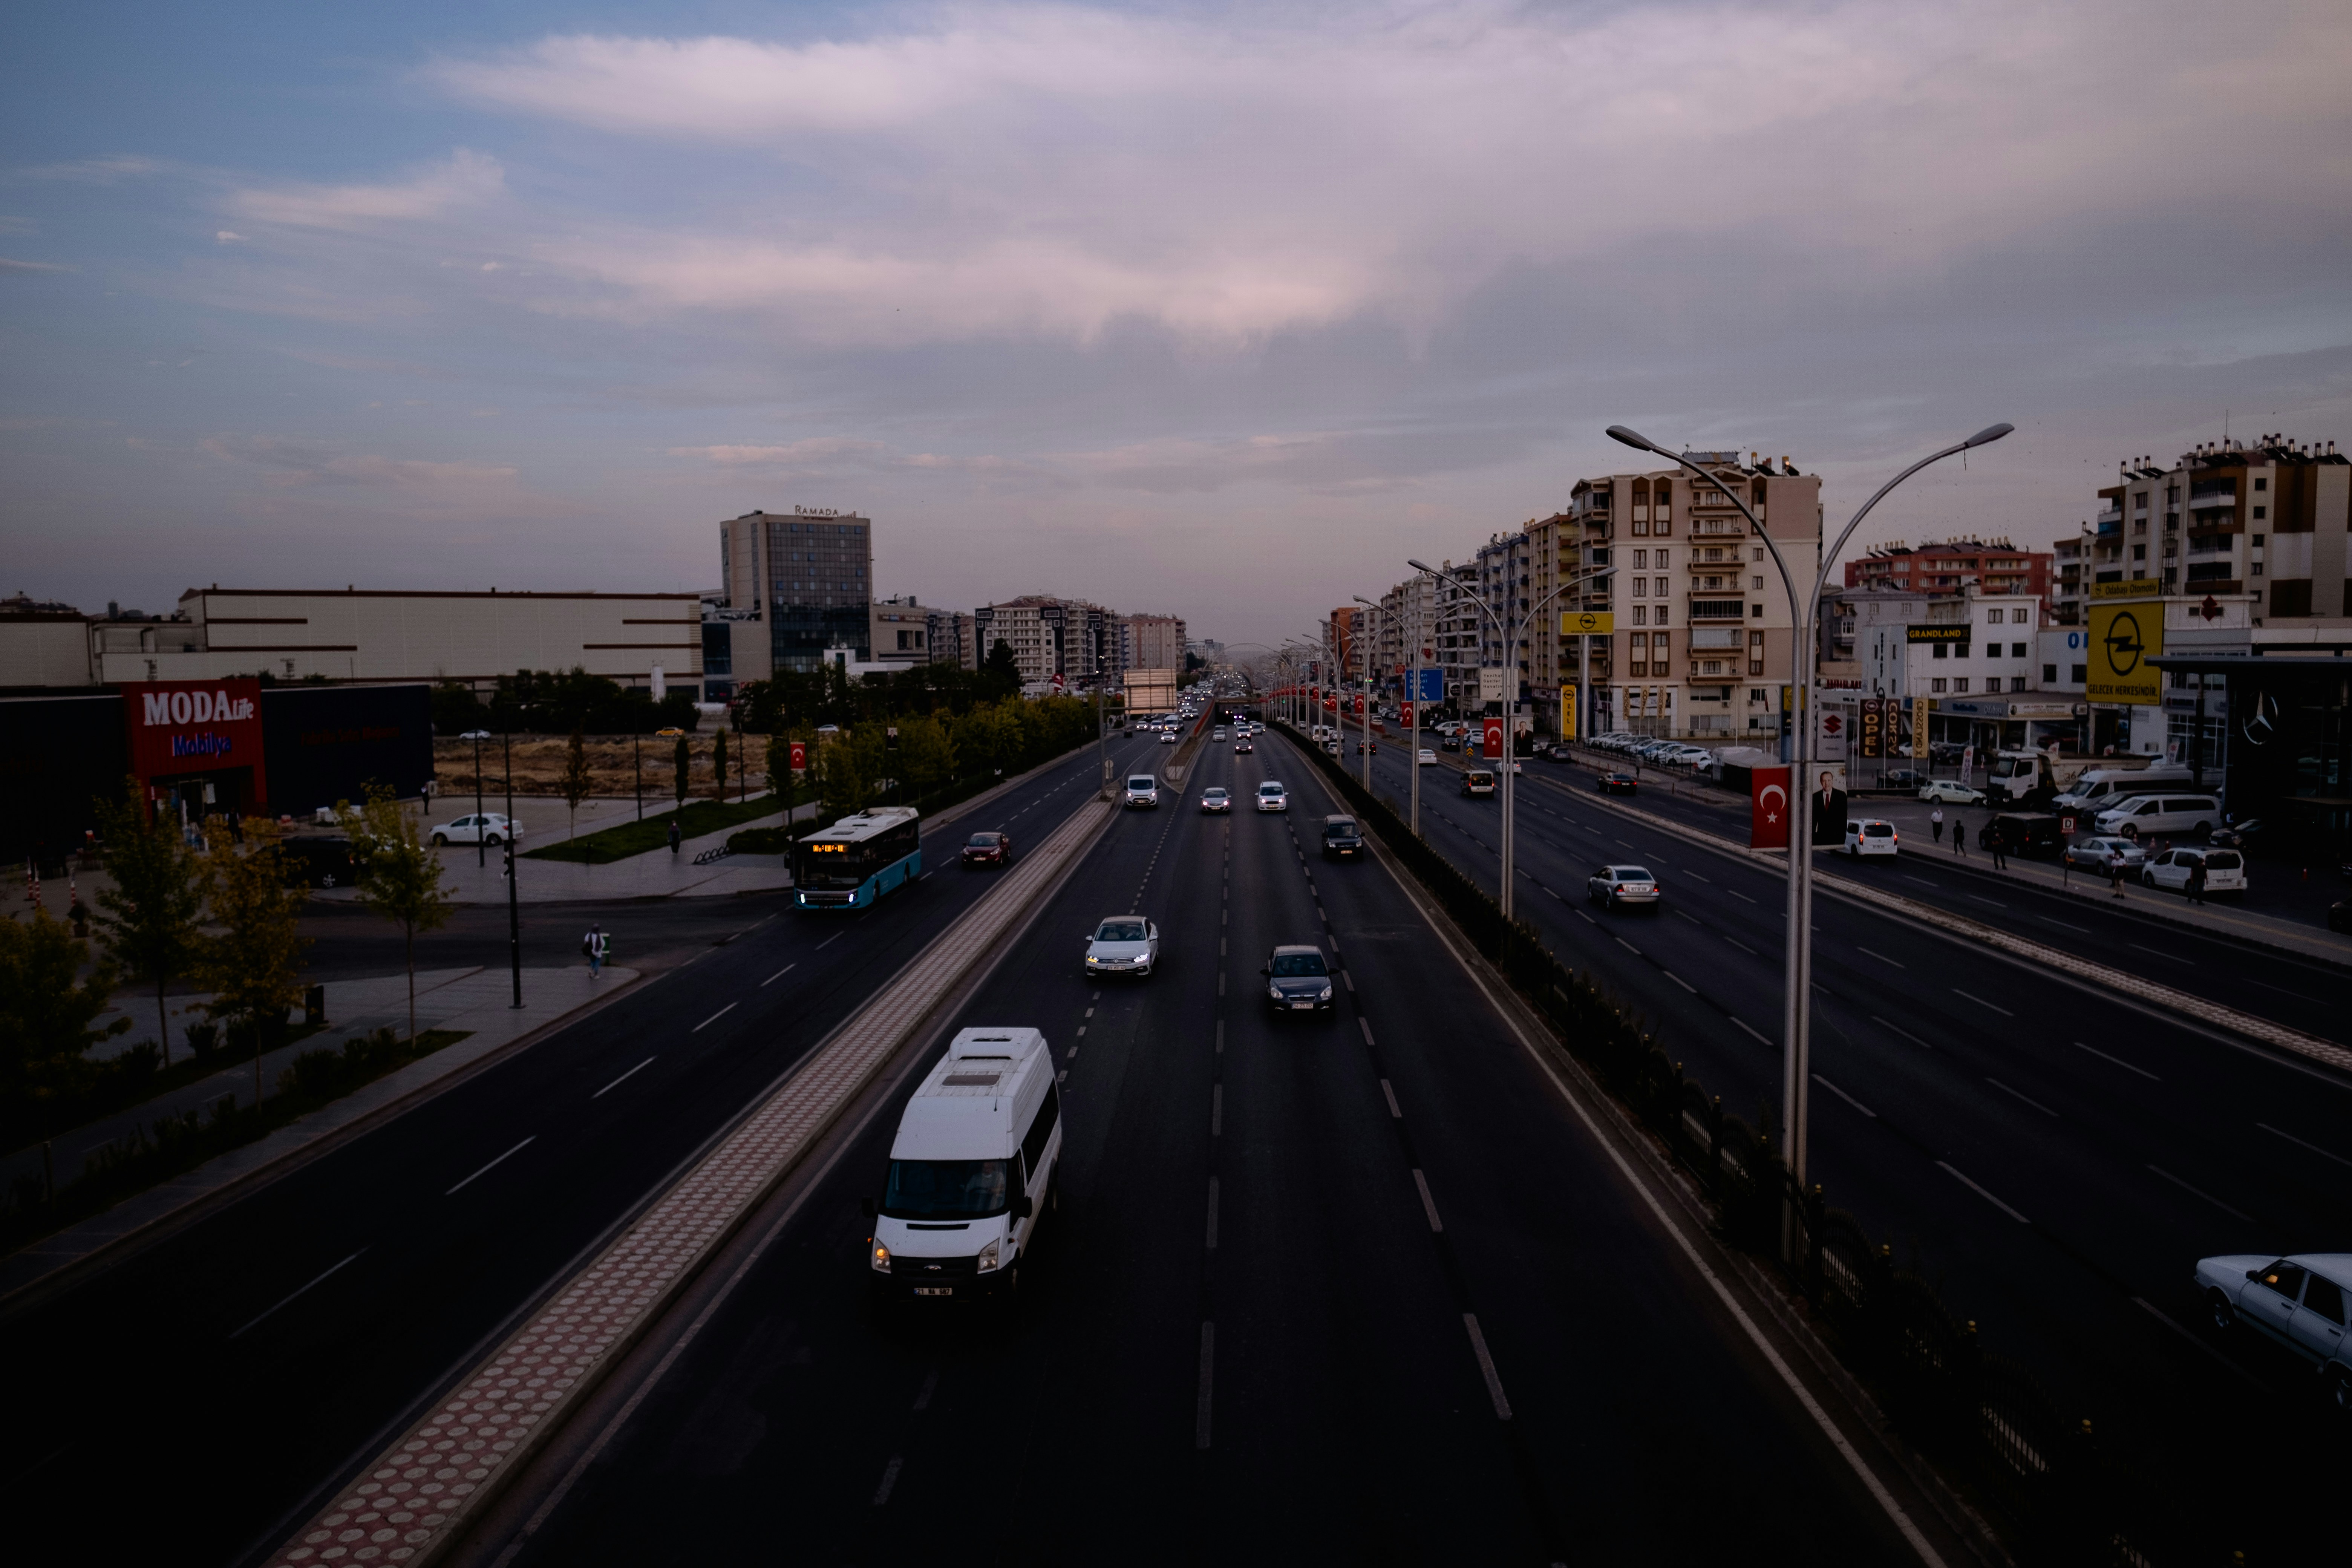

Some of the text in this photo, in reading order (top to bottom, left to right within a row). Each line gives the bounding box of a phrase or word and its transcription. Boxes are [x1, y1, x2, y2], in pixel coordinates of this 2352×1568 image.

[795, 505, 838, 516] RAMADA
[2105, 583, 2157, 595] Odabaşı Otomotiv
[1909, 629, 1961, 639] GRANDLAND
[2088, 683, 2158, 697] GELECEK HERKESİNDİR.
[142, 690, 233, 726] MODA
[1864, 713, 1879, 757] OPEL
[172, 731, 231, 759] Mobilya
[2065, 819, 2072, 828] D
